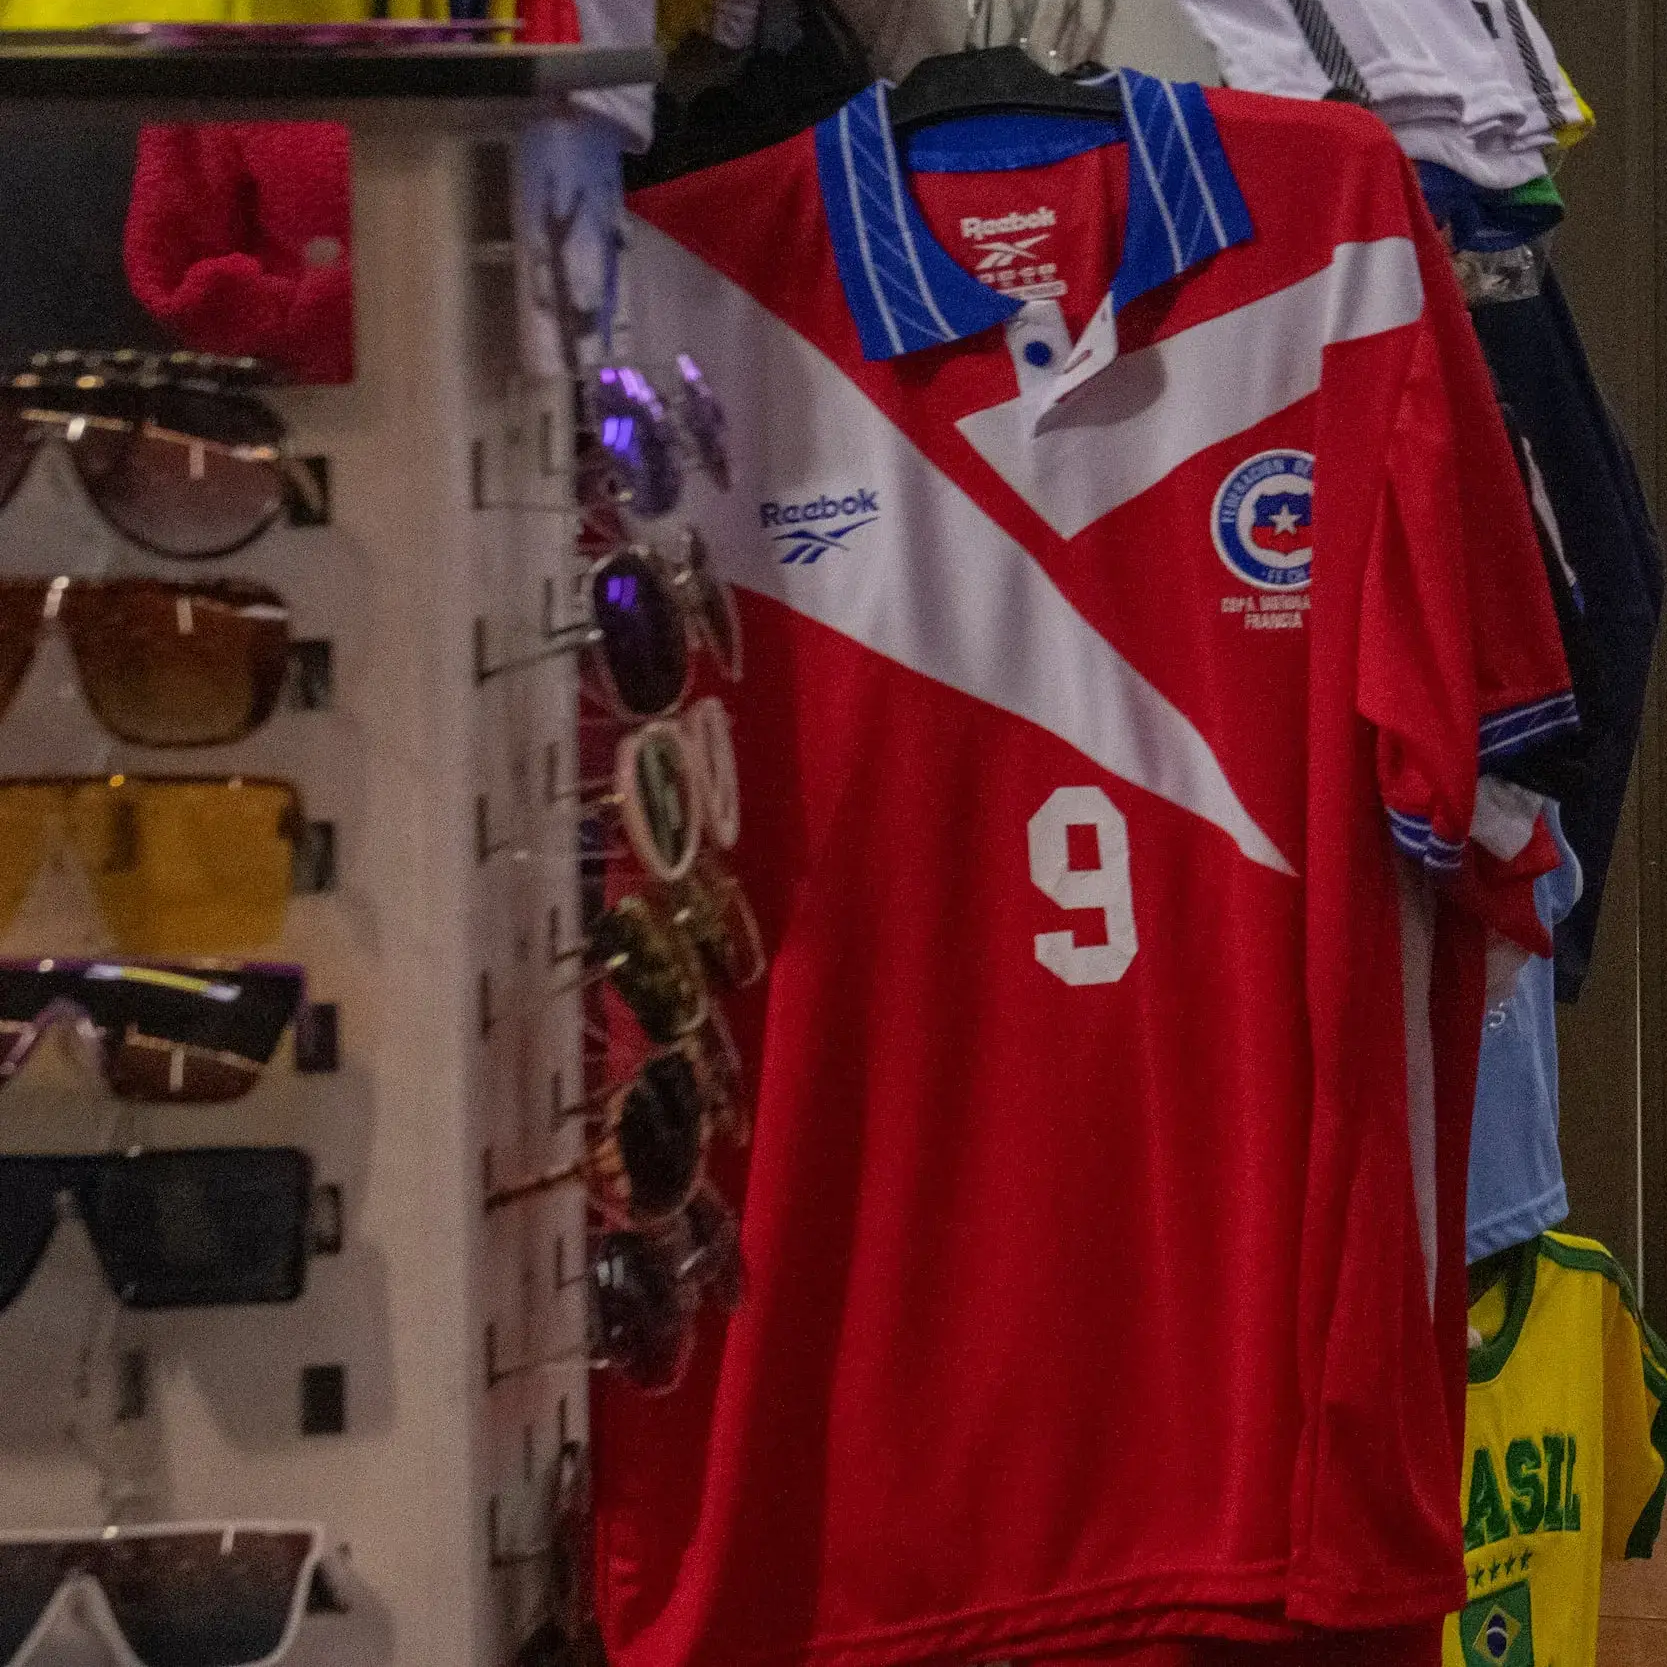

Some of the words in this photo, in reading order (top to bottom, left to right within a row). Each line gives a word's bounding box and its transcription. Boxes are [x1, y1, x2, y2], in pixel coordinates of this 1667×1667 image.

[960, 206, 1057, 240] Reebok
[759, 488, 880, 529] Reebok
[1026, 784, 1139, 987] 9
[1463, 1432, 1582, 1554] ASIL
